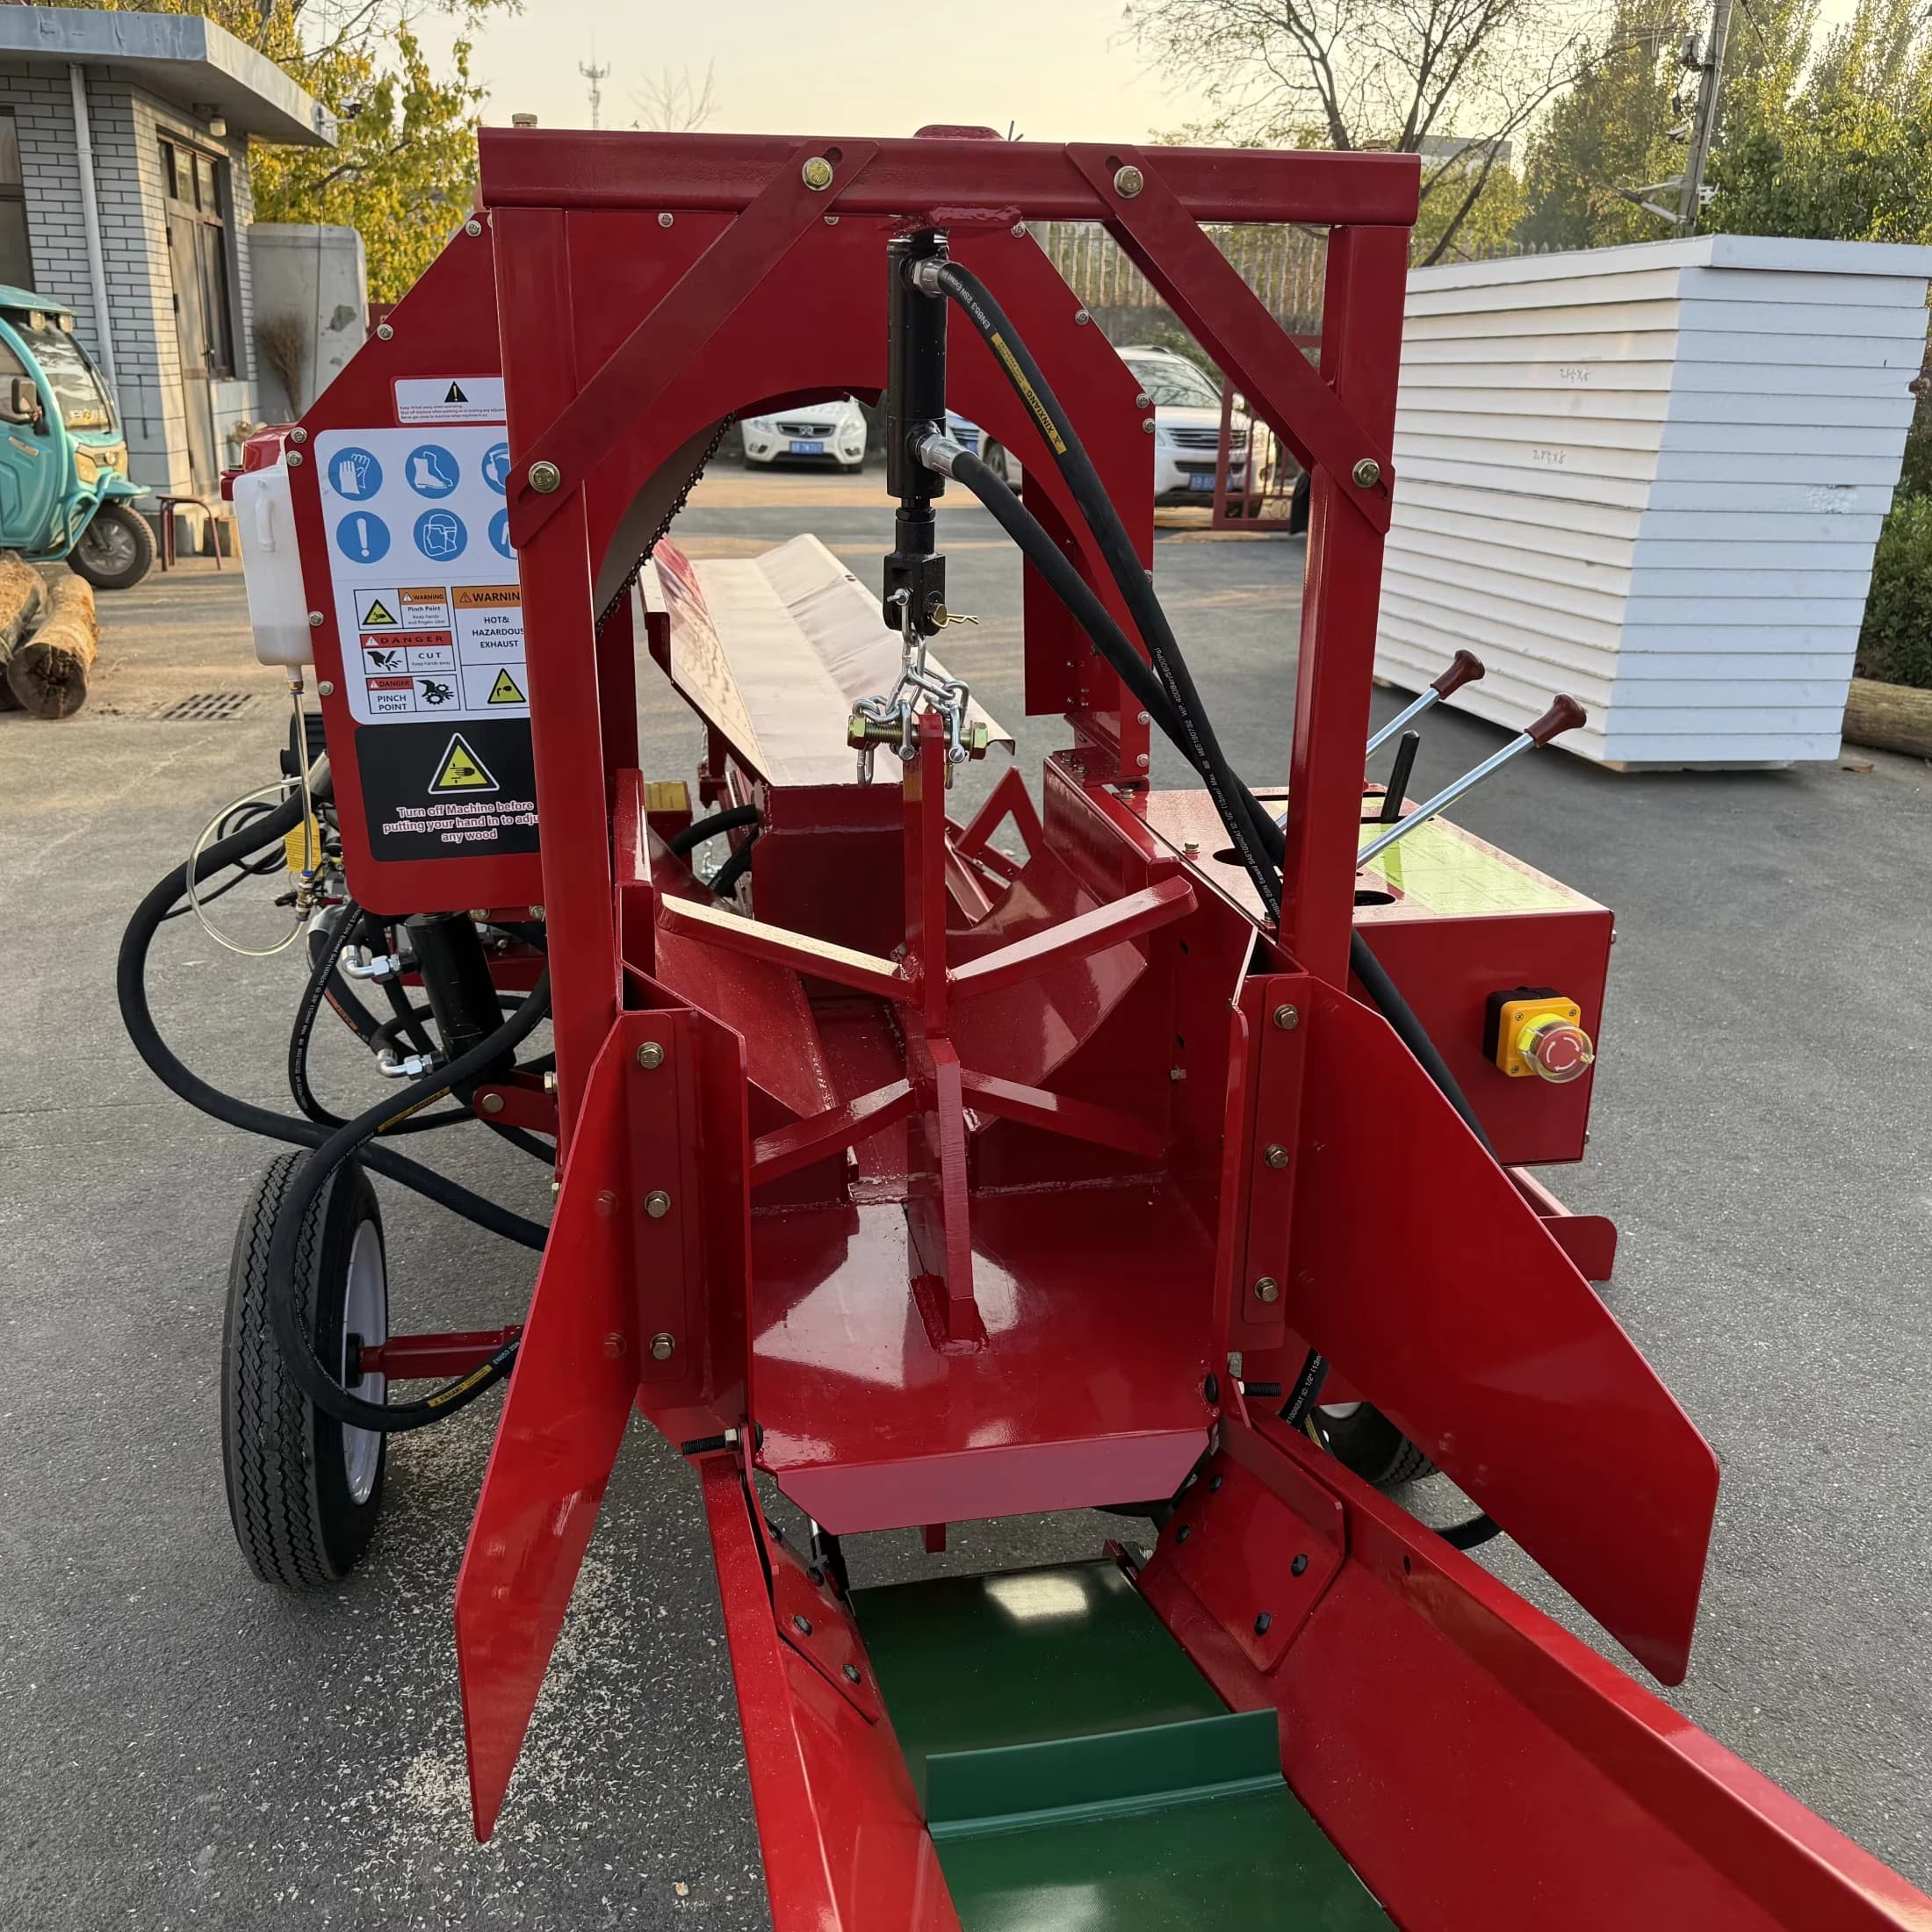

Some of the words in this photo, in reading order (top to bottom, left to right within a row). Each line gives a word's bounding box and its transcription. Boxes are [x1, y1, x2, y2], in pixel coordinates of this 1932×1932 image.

[960, 287, 973, 303] 2SN
[970, 302, 991, 329] EN853
[1025, 389, 1054, 433] XINXIANG
[472, 592, 520, 602] WARNIN
[396, 806, 426, 818] Turn
[427, 804, 444, 816] off
[446, 803, 495, 815] Machine
[495, 800, 534, 812] before
[383, 820, 425, 834] putting
[426, 819, 454, 833] your
[456, 816, 486, 828] hand
[487, 815, 500, 825] in
[501, 814, 514, 825] to
[515, 812, 539, 825] adju
[441, 833, 464, 843] any
[465, 828, 498, 840] wood
[1285, 1395, 1305, 1424] E100R2AT
[1310, 1354, 1323, 1373] (13m
